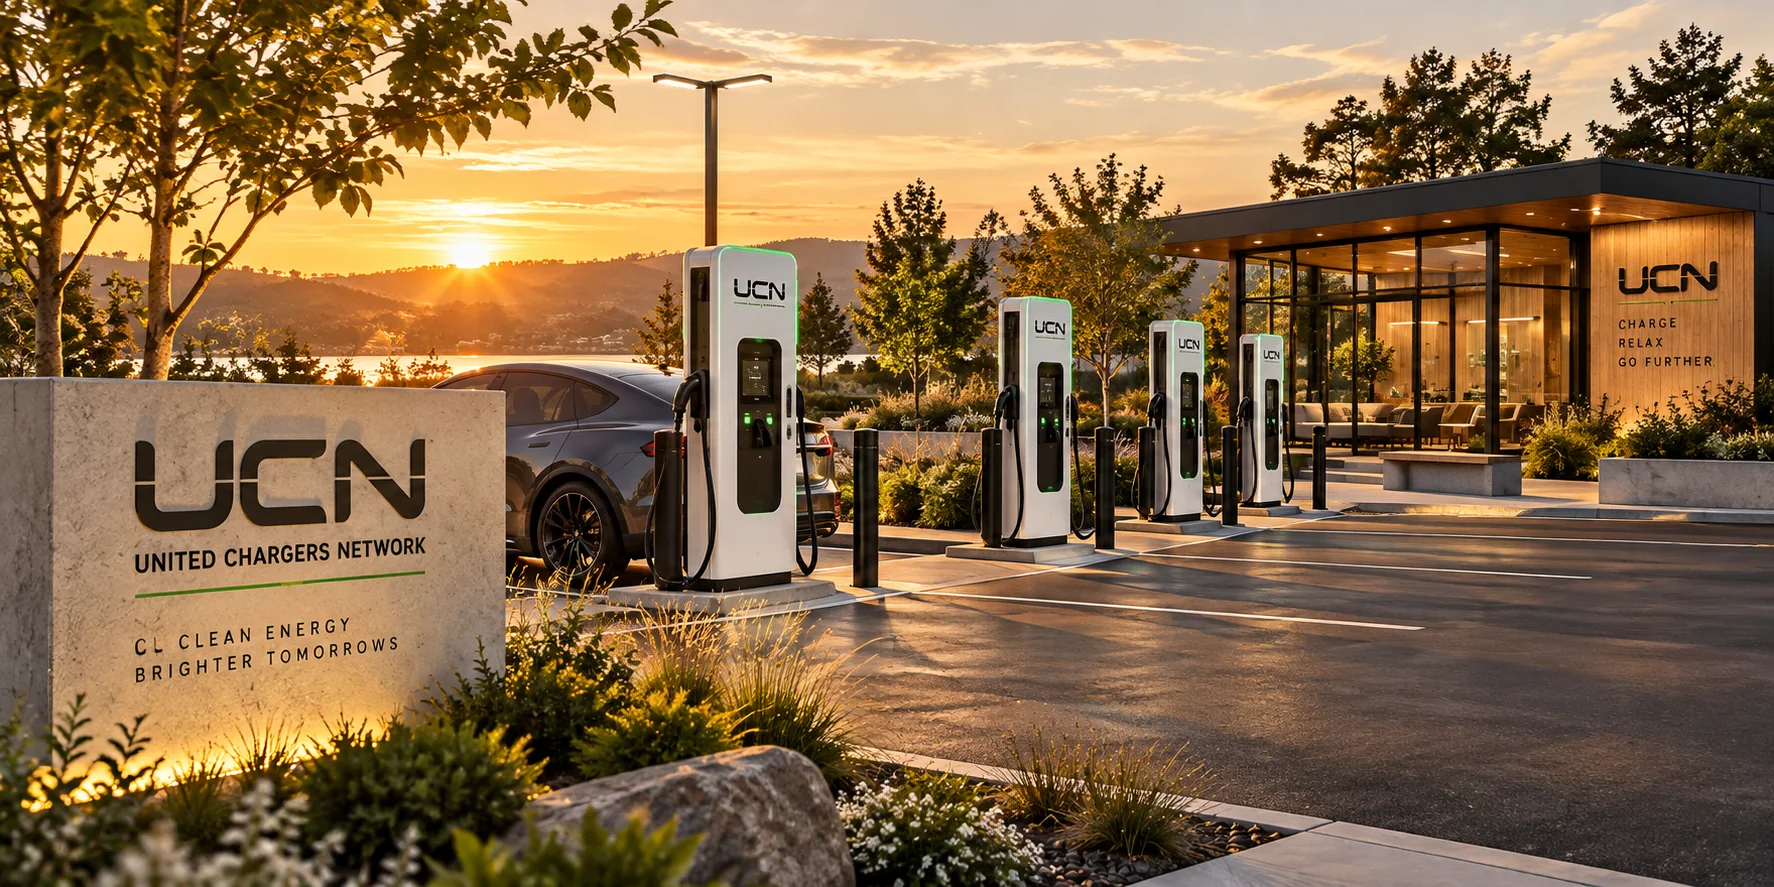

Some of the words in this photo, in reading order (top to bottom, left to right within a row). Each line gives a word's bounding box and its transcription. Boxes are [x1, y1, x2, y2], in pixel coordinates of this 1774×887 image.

[1618, 261, 1718, 295] UCN
[734, 278, 785, 301] UCN
[1034, 319, 1066, 335] UCN
[1618, 317, 1677, 330] CHARGE
[1178, 338, 1200, 350] UCN
[1618, 337, 1663, 348] RELAX
[1263, 349, 1280, 360] UCN
[1618, 357, 1637, 367] GO
[135, 439, 426, 532] UCN
[135, 550, 216, 574] UNITED
[224, 543, 330, 567] CHARGERS
[338, 537, 426, 560] NETWORK
[135, 637, 163, 655] CL
[179, 627, 251, 650] CLEAN
[266, 618, 350, 640] ENERGY
[135, 654, 252, 683] BRIGHTER
[267, 637, 398, 665] TOMORROWS
